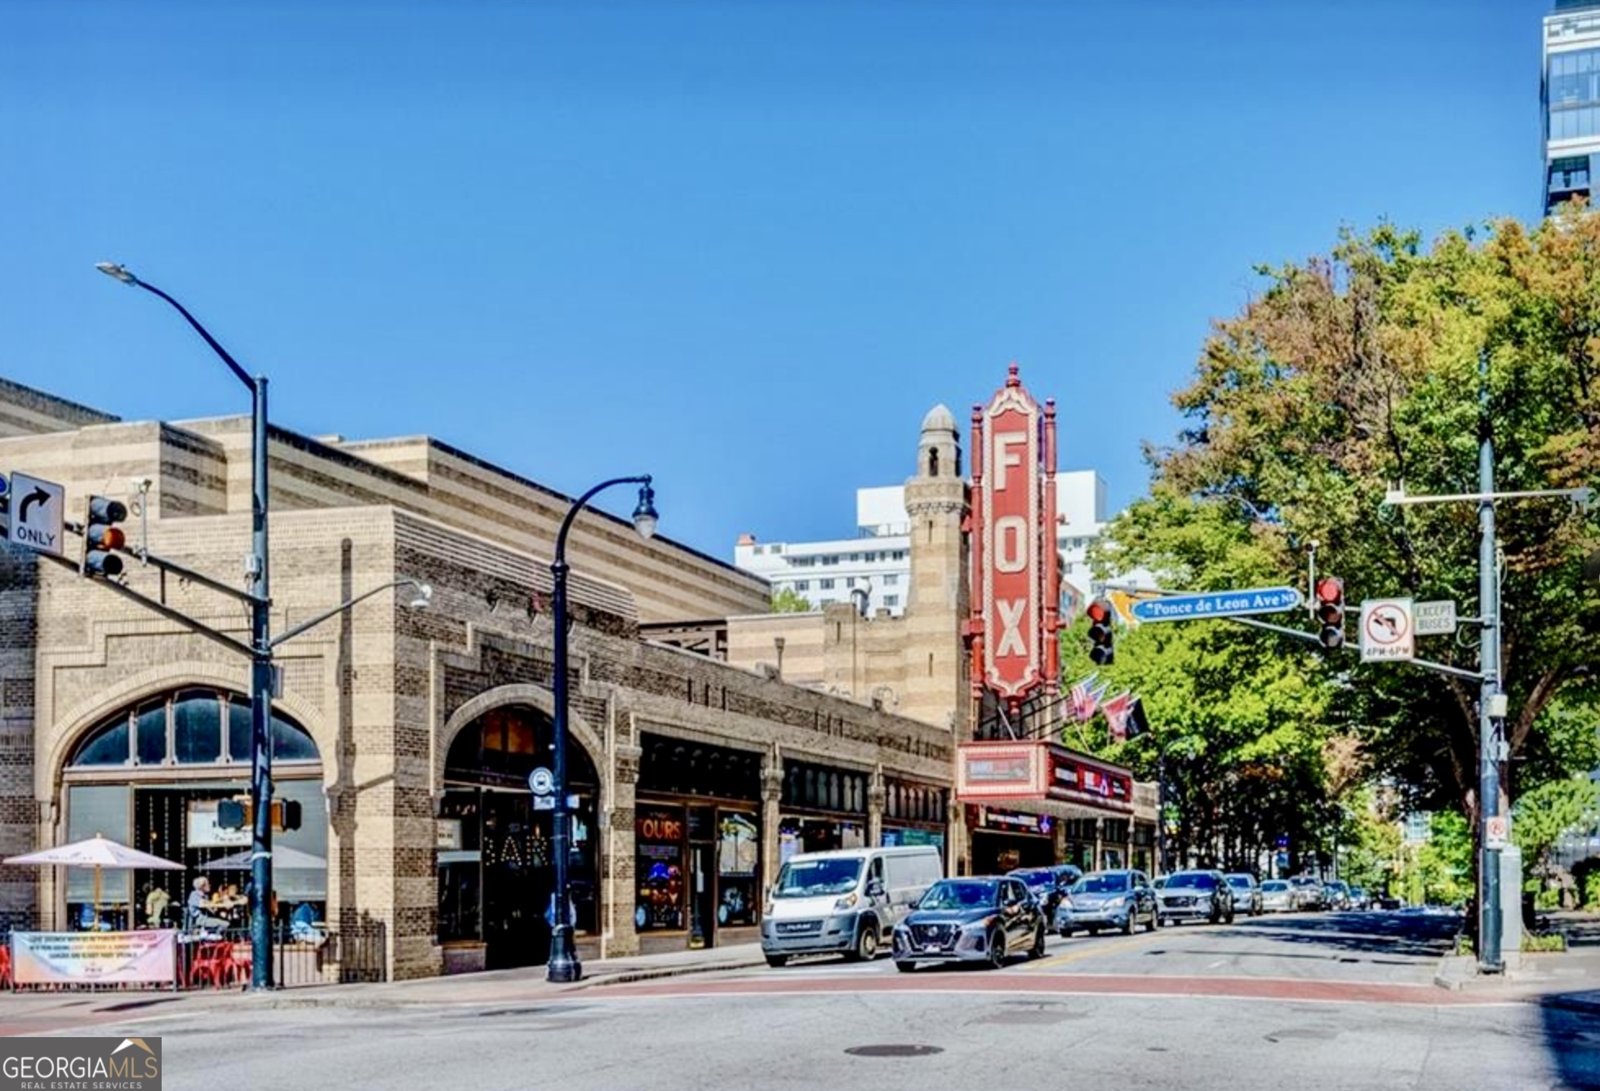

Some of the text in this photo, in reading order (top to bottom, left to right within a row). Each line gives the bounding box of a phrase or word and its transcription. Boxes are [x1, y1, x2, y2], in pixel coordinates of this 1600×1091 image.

[17, 526, 56, 546] ONLY
[994, 431, 1028, 657] FOX
[1154, 603, 1191, 616] Ponce
[1196, 598, 1212, 611] de
[1216, 597, 1249, 610] Leon
[1254, 594, 1279, 607] Ave
[1416, 605, 1452, 617] EXCEPT
[1418, 619, 1451, 630] BUSES
